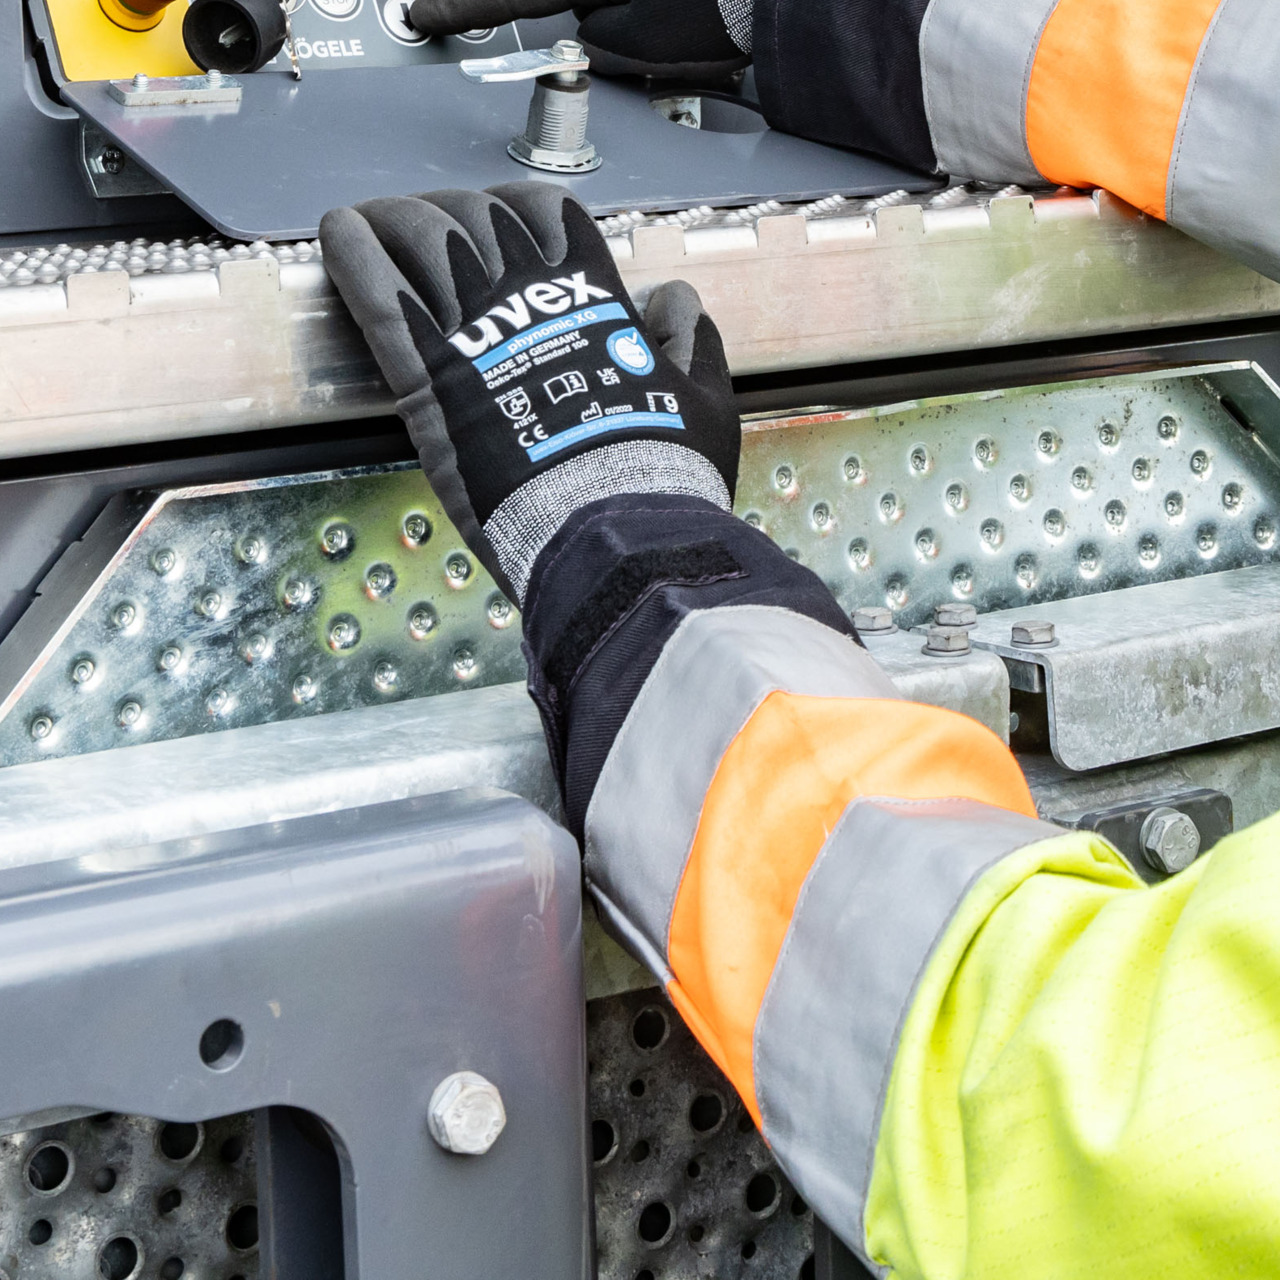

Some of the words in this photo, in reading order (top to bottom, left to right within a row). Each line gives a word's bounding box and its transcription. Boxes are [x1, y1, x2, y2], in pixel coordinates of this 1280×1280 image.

[448, 271, 613, 357] uvex
[507, 318, 575, 354] phynomic
[574, 310, 598, 325] XG
[482, 359, 517, 382] MADE
[515, 352, 530, 364] IN
[529, 330, 581, 357] GERMANY
[532, 344, 572, 366] Standard
[572, 338, 589, 350] 100
[596, 367, 618, 377] UK
[601, 375, 620, 386] CA
[604, 404, 633, 416] 01/2023
[663, 395, 678, 413] 9
[513, 412, 539, 430] 4121X
[518, 423, 549, 447] CE
